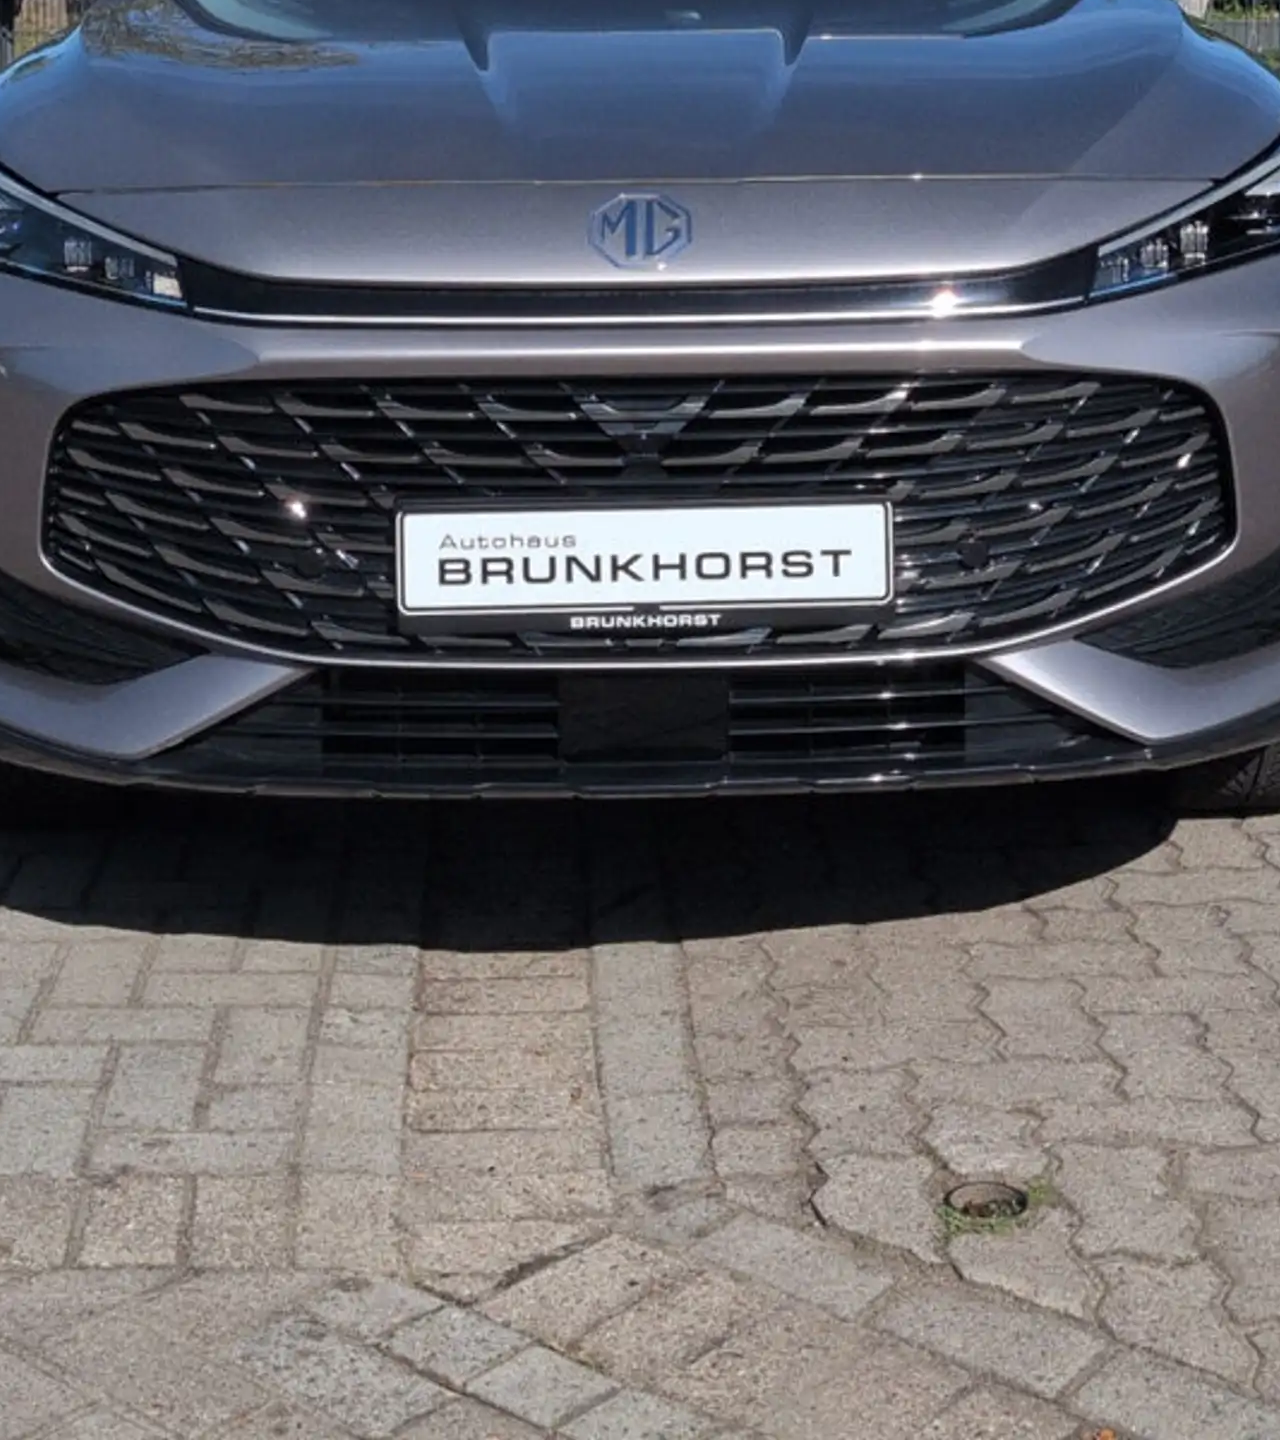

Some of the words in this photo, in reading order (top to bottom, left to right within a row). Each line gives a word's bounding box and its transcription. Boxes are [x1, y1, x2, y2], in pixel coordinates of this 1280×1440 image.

[599, 199, 686, 261] MG
[438, 533, 577, 550] Autohaus
[438, 549, 852, 586] BRUNKHORST
[570, 613, 721, 629] BRUNKHORST
